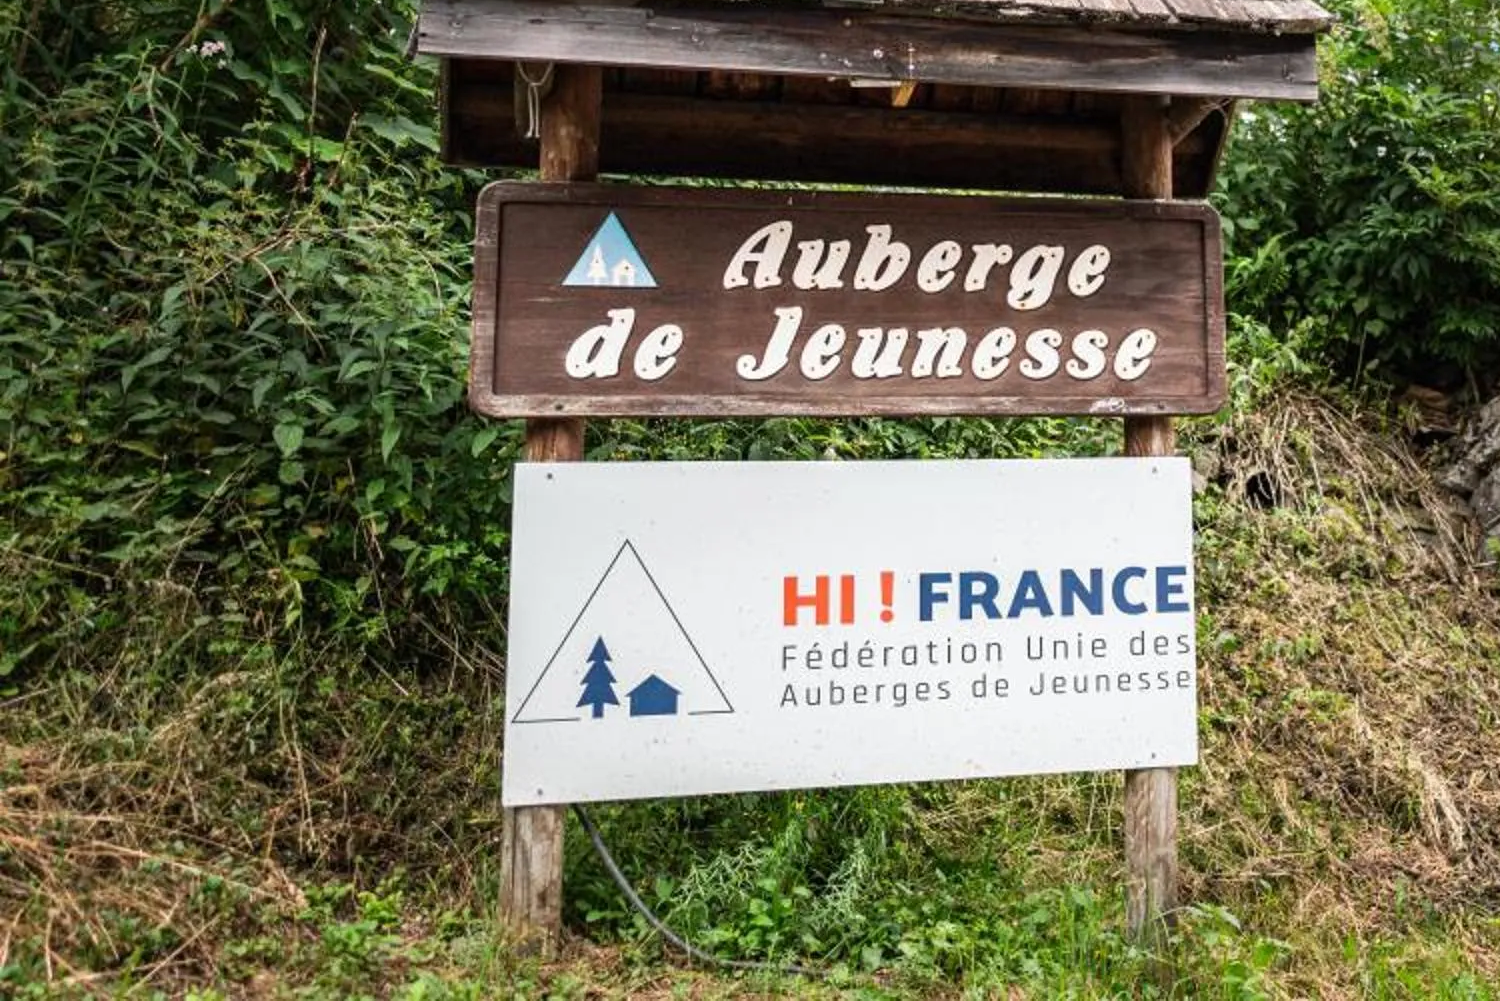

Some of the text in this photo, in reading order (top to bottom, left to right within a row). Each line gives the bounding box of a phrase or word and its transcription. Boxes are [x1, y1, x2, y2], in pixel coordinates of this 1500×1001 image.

[722, 220, 1112, 310] Auberge
[564, 306, 1157, 381] de Jeunesse
[782, 574, 855, 626] HI
[918, 565, 1191, 622] FRANCE
[781, 630, 1191, 671] Fédération Unie des
[780, 670, 1191, 707] Auberges de Jeunesse
